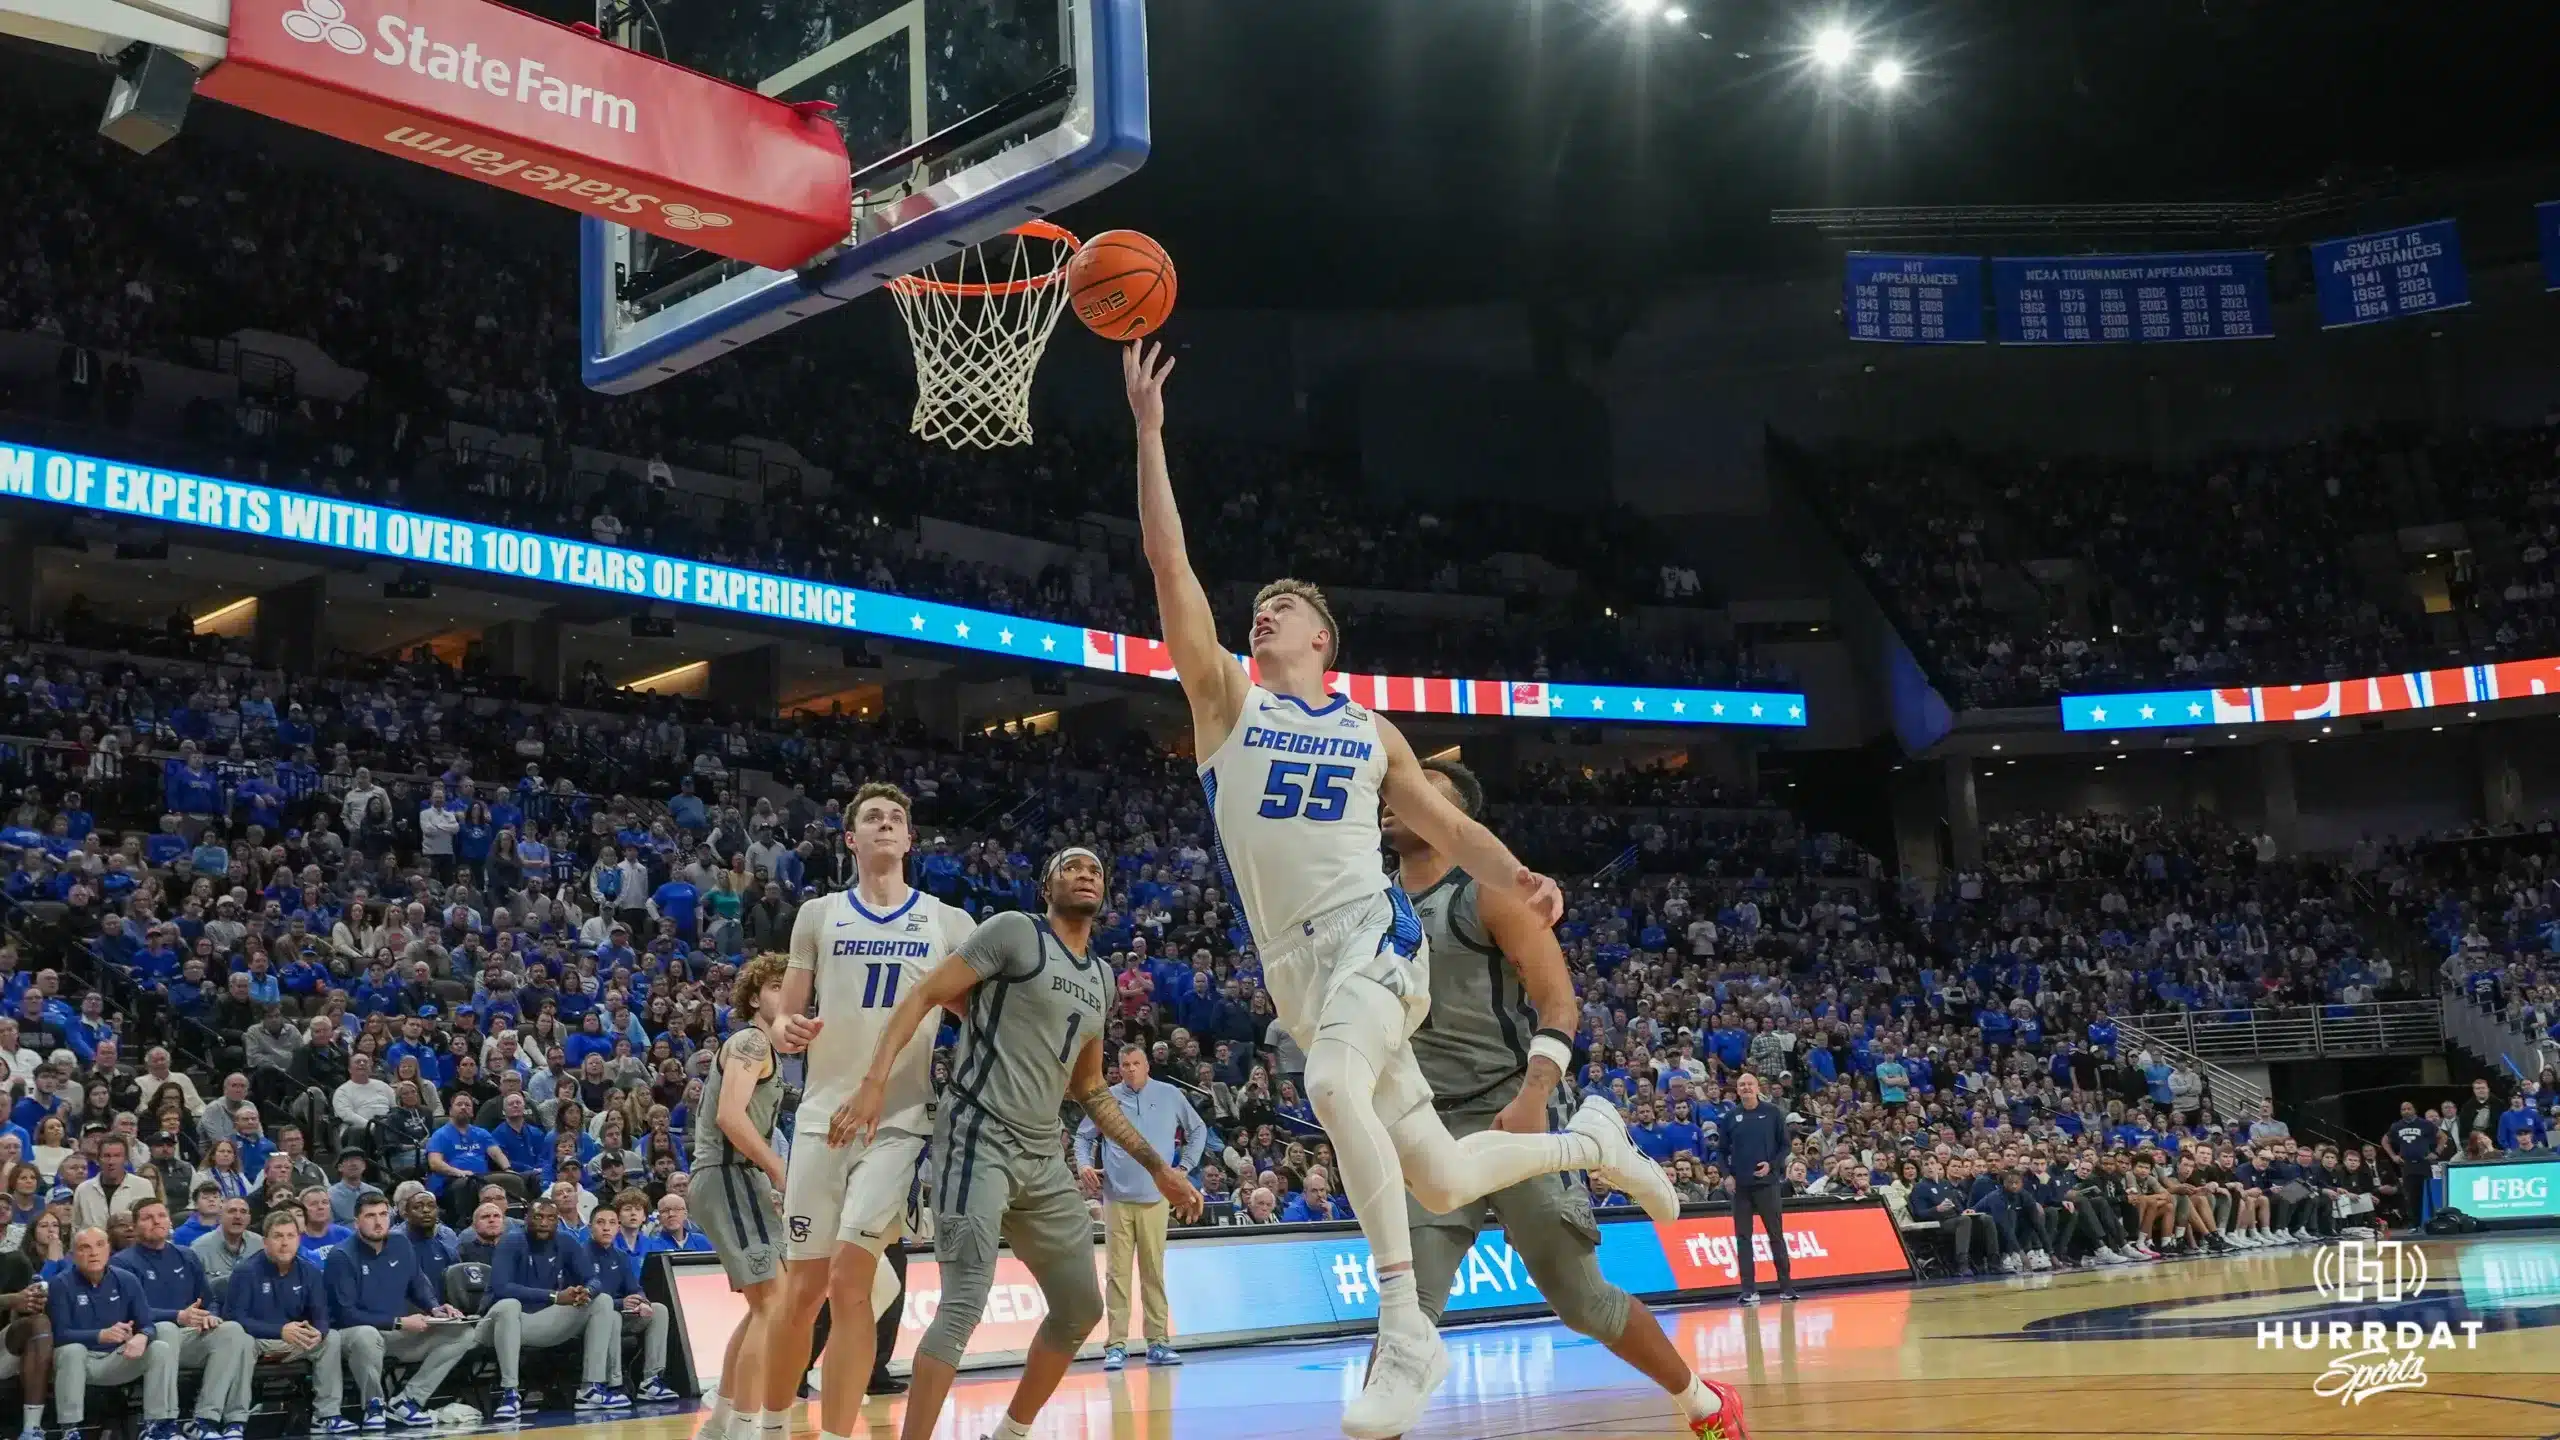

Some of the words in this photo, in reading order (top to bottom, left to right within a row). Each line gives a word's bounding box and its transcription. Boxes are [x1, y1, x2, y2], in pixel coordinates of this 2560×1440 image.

[2346, 236, 2399, 257] SWEET
[2406, 232, 2422, 247] 16
[1903, 260, 1924, 273] NIT
[2333, 243, 2443, 274] APPEARANCES
[1871, 271, 1959, 285] APPEARANCES
[2026, 269, 2060, 280] NCAA
[2062, 267, 2144, 280] TOURNAMENT
[2147, 264, 2234, 279] APPEARANCES
[2351, 270, 2381, 287] 1941
[2396, 261, 2429, 279] 1974
[1856, 285, 1878, 297] 1942
[2020, 288, 2043, 301] 1941
[2059, 288, 2085, 301] 1975
[2138, 287, 2166, 299] 2002
[2180, 285, 2205, 298] 2012
[2220, 283, 2246, 296] 2018
[2353, 285, 2387, 302] 1962
[2398, 277, 2432, 294] 2021
[1857, 298, 1879, 310] 1943
[2020, 301, 2046, 314] 1962
[2061, 301, 2086, 314] 1978
[2139, 300, 2168, 312] 2003
[2181, 298, 2208, 310] 2013
[2221, 297, 2248, 309] 2021
[2354, 300, 2389, 318] 1964
[2399, 292, 2437, 309] 2023
[2101, 314, 2129, 326] 2000
[2142, 312, 2170, 325] 2005
[2183, 311, 2209, 323] 2014
[2222, 310, 2251, 322] 2022
[2023, 328, 2048, 340] 1974
[2103, 327, 2129, 339] 2001
[2143, 325, 2170, 338] 2007
[2184, 324, 2210, 336] 2017
[2224, 323, 2253, 335] 2023
[45, 455, 97, 504] OF
[104, 464, 272, 533] EXPERTS
[279, 495, 378, 551] WITH
[386, 513, 474, 566] OVER
[481, 530, 542, 577] 100
[549, 540, 647, 593] YEARS
[653, 559, 689, 600] OF
[695, 566, 857, 627] EXPERIENCE
[1243, 726, 1373, 762] CREIGHTON
[1257, 759, 1356, 822] 55
[833, 939, 930, 958] CREIGHTON
[862, 962, 902, 1009] 11
[1051, 975, 1102, 1013] BUTLER
[1059, 1011, 1082, 1064] 1
[2491, 1176, 2548, 1201] FBG
